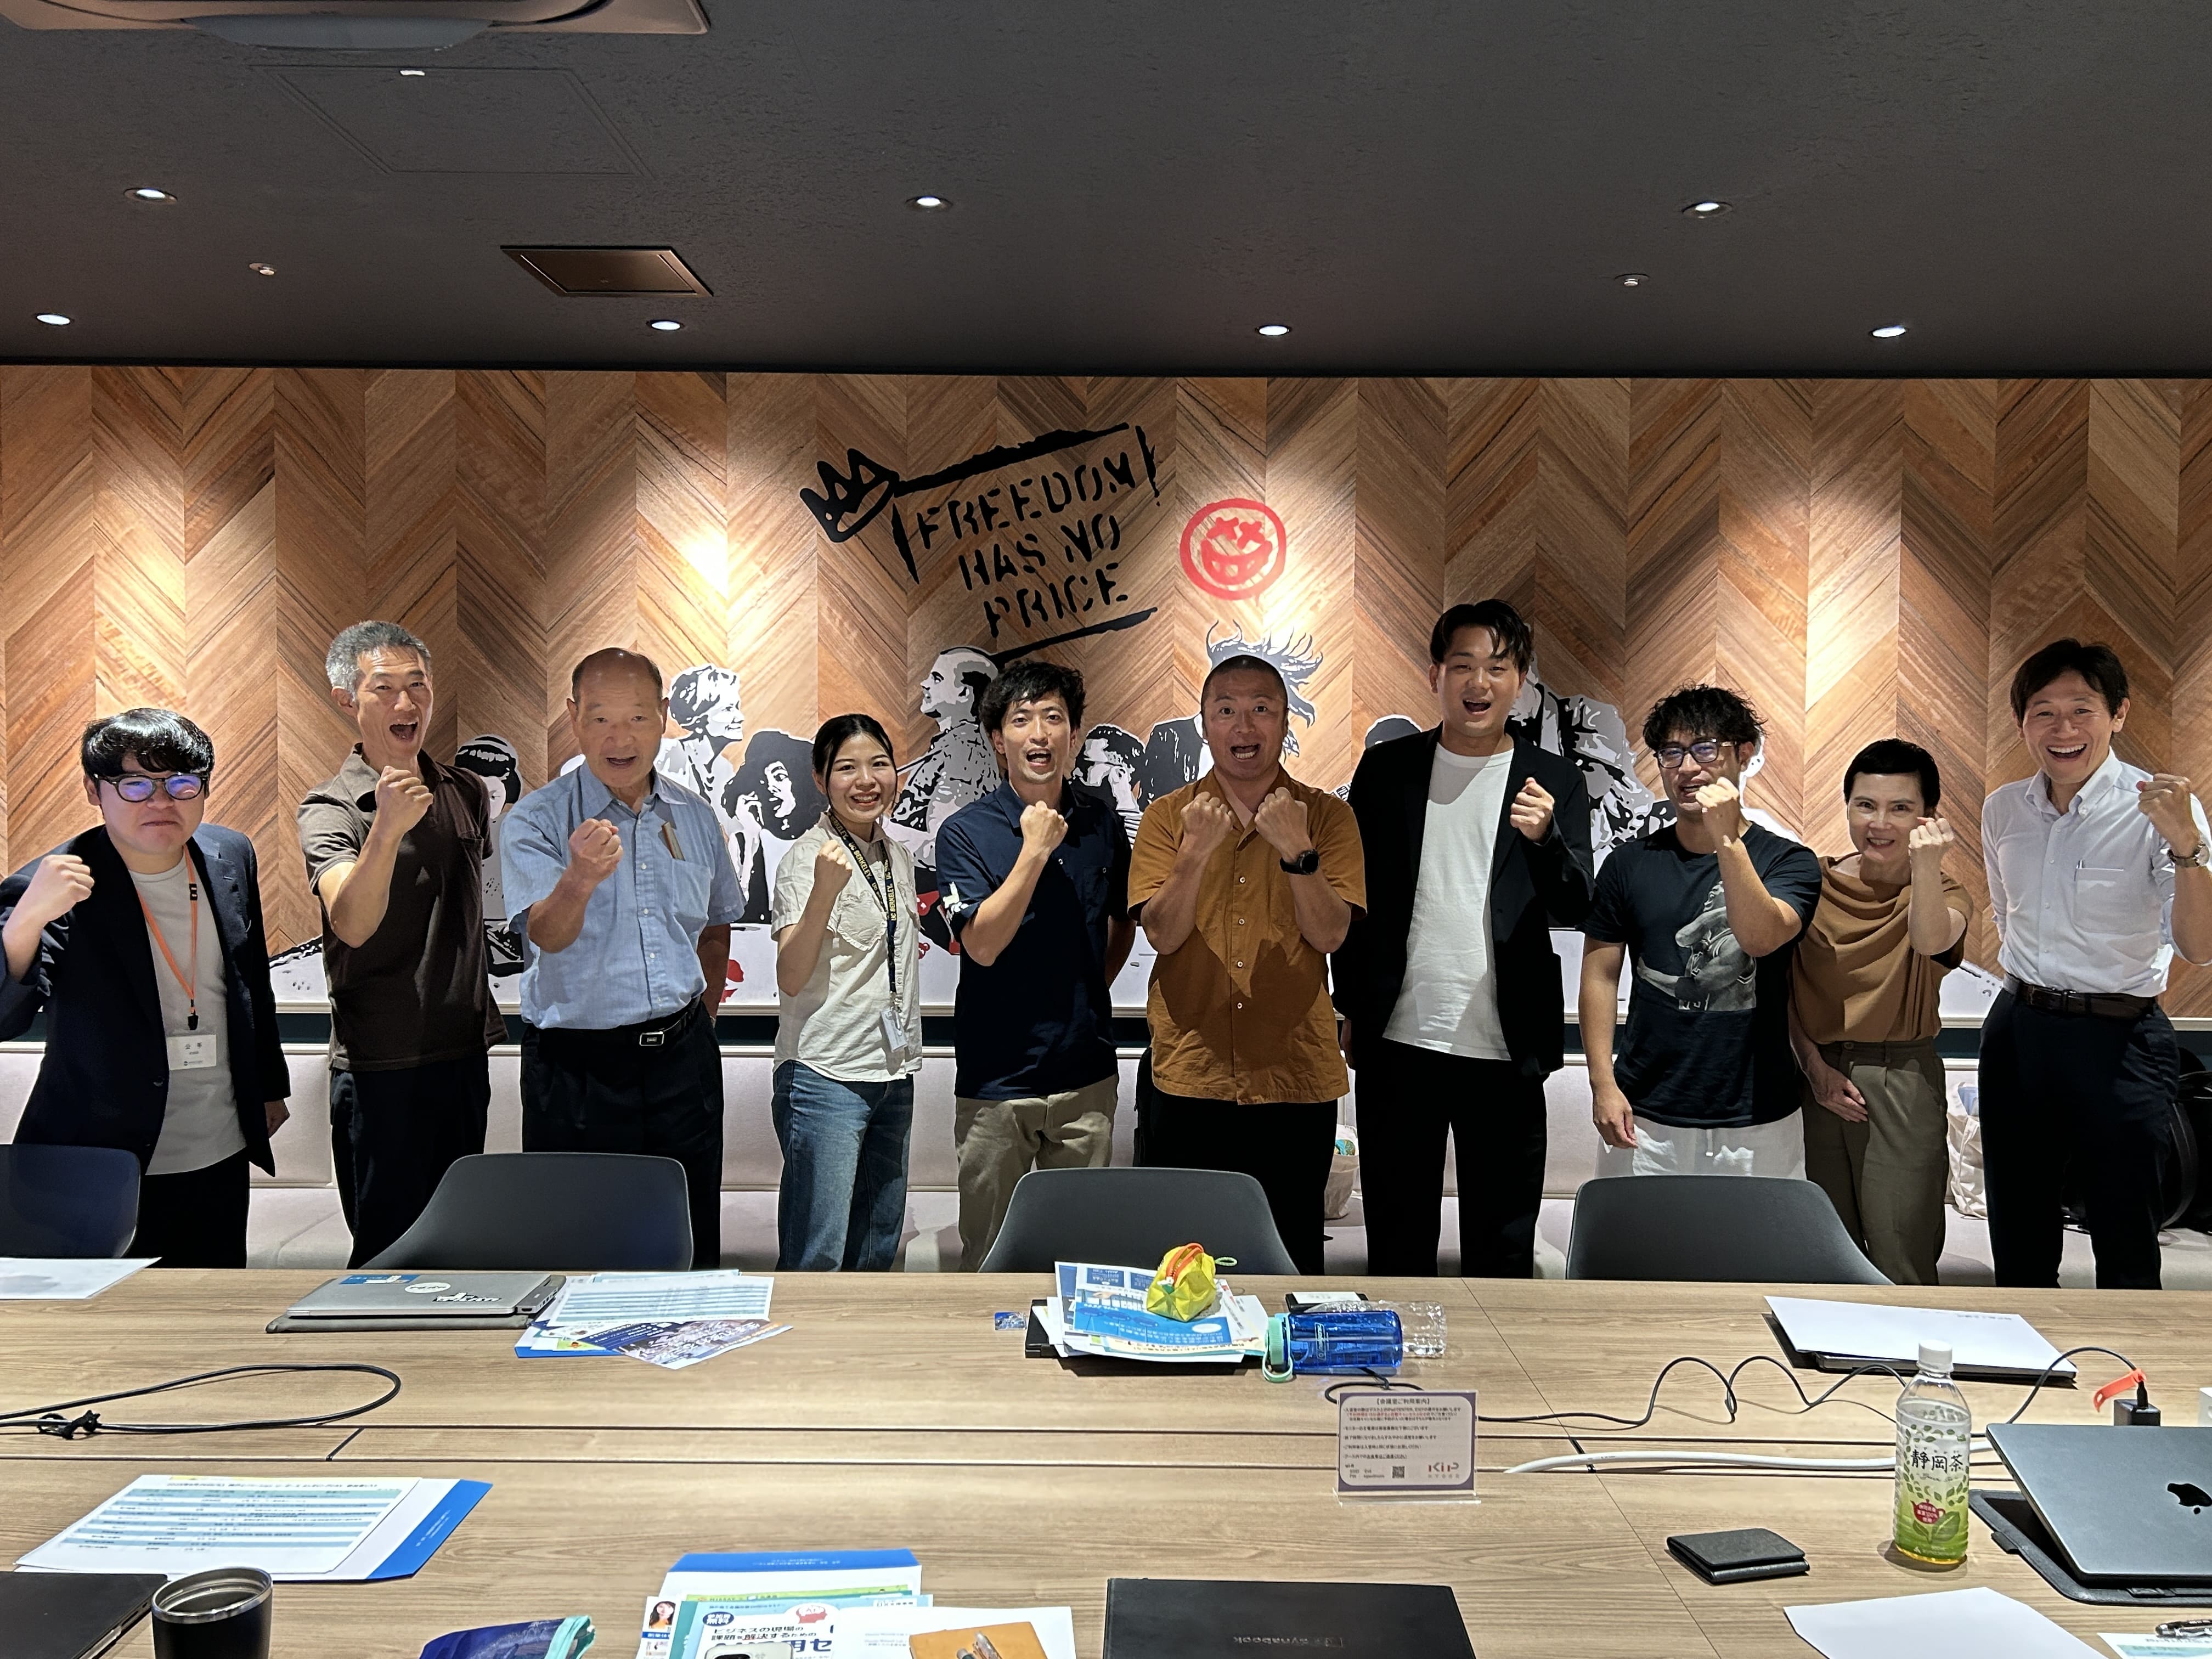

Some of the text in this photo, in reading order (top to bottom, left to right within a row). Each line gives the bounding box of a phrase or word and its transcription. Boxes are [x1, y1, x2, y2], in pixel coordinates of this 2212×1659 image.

[917, 452, 1136, 549] FREEDOM
[958, 513, 1121, 591] HAS NO
[983, 562, 1128, 638] PRICE
[849, 842, 857, 850] UC
[890, 912, 896, 921] UC
[1910, 1449, 1963, 1474] 静岡茶
[711, 1632, 817, 1641] 課題を解決するための
